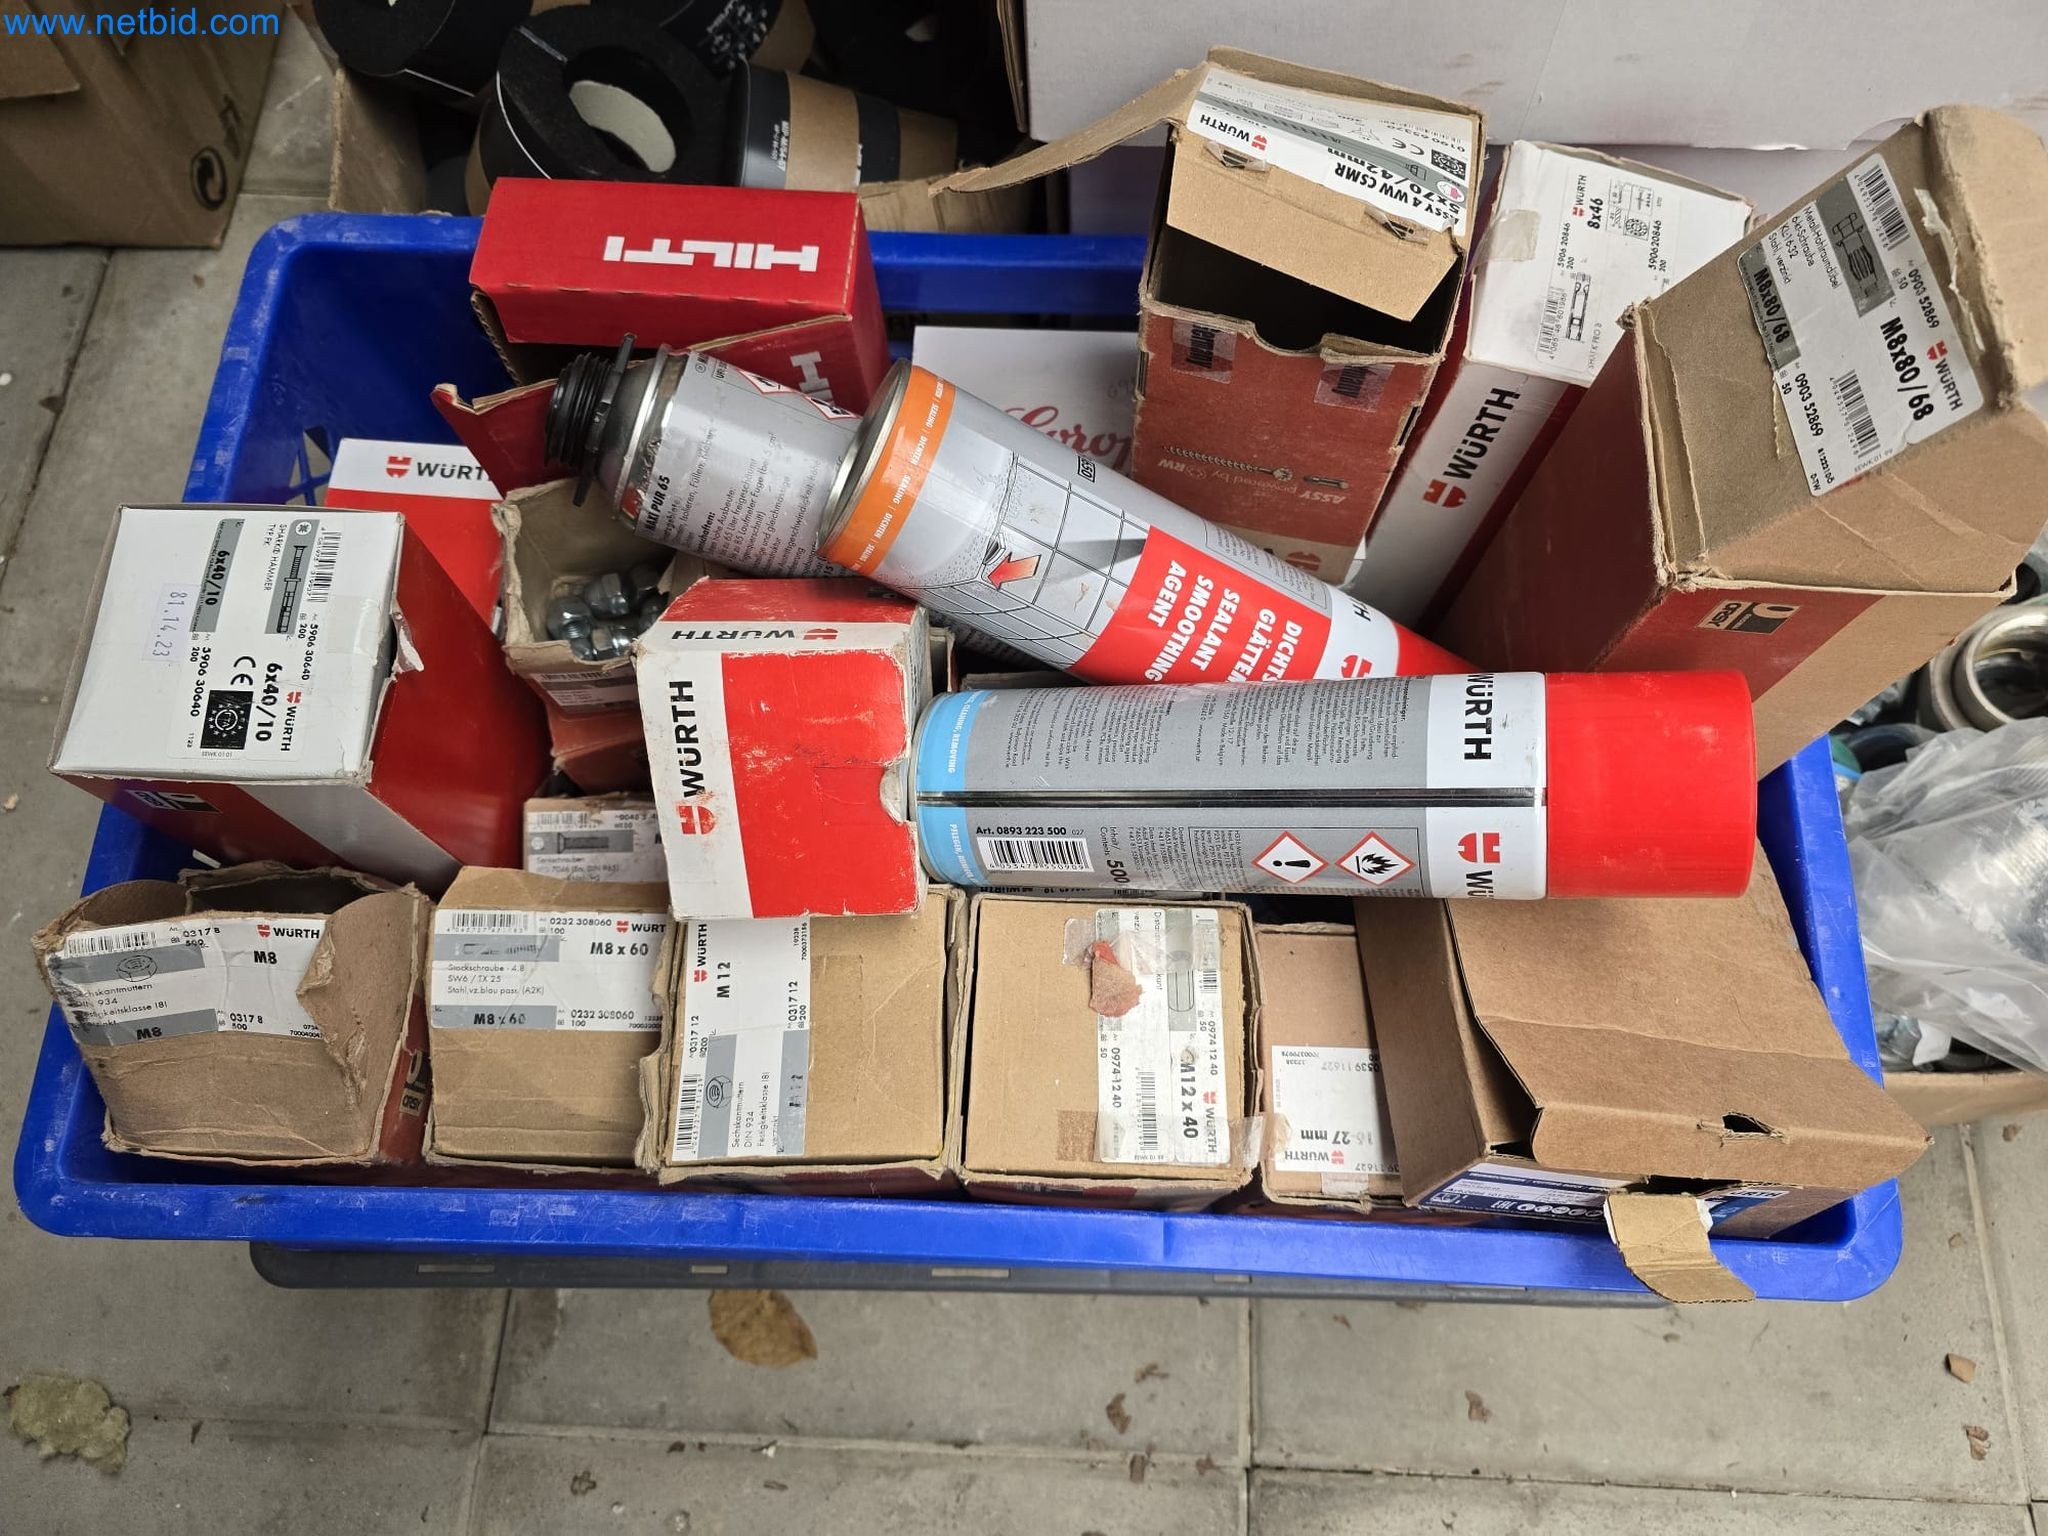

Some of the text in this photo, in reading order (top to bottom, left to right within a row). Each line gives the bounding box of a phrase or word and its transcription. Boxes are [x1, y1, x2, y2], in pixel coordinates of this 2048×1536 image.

[1200, 113, 1249, 142] WÜRTH
[1335, 162, 1378, 189] CSMR
[1379, 181, 1410, 203] WW
[1587, 197, 1604, 231] 8x46
[603, 235, 819, 272] HILTI
[1566, 256, 1574, 270] 200
[1658, 259, 1667, 272] 200
[1753, 268, 1790, 344] M8x80/68
[1909, 268, 1940, 329] 0903 52869
[1880, 316, 1934, 421] M8x80/68
[1782, 382, 1791, 395] 50
[1935, 357, 1963, 411] WÜRTH
[1794, 373, 1824, 437] 0903 52869
[1443, 387, 1521, 480] WÜRTH
[912, 435, 928, 466] DICHTEN
[416, 459, 488, 482] WÜRT
[651, 491, 665, 514] PUR
[660, 474, 671, 493] 65
[895, 474, 912, 506] SEALING
[1300, 491, 1346, 504] ASSY
[875, 513, 893, 541] DICHTEN
[204, 550, 231, 606] 6x40/10
[1147, 560, 1187, 628] AGENT
[151, 589, 188, 658] 81.14.23
[298, 623, 307, 639] 200
[671, 630, 796, 640] WÜRTH
[1144, 574, 1214, 681] SMOOTHING
[1191, 588, 1240, 671] SEALANT
[189, 646, 200, 663] 200
[301, 623, 318, 681] 5906 30640
[1261, 621, 1303, 682] DICHTS
[190, 647, 211, 717] 5906 30640
[255, 662, 283, 743] 6x40/10
[280, 706, 297, 752] WÜRTH
[1464, 674, 1493, 761] WÜRTH
[669, 680, 706, 798] WÜRTH
[947, 734, 960, 774] REMOVING
[976, 826, 995, 836] Art.
[997, 826, 1024, 836] 0893
[1025, 826, 1045, 836] 223
[1047, 826, 1067, 836] 500
[1106, 859, 1131, 884] 500
[273, 927, 320, 939] WÜRTH
[549, 918, 612, 927] 0232 308060
[550, 927, 565, 935] 100
[631, 924, 666, 933] WÜRT
[253, 950, 278, 965] M8
[590, 942, 649, 956] M8 x 60
[697, 924, 708, 967] WÜRTH
[448, 974, 469, 983] SW6
[490, 975, 502, 983] 25
[521, 985, 545, 996] (A2K)
[717, 961, 731, 998] M 12
[789, 981, 798, 995] 12
[229, 1013, 264, 1024] 0317 8
[473, 1013, 495, 1025] M8
[509, 1013, 527, 1025] 60
[571, 1010, 634, 1020] 0232 308060
[691, 1015, 699, 1028] 12
[798, 1004, 807, 1022] 200
[137, 1027, 162, 1040] M8
[1199, 1021, 1207, 1032] 50
[701, 1036, 709, 1052] 200
[1100, 1048, 1108, 1059] 50
[1208, 1020, 1218, 1076] 0974 12 40
[1111, 1047, 1121, 1075] 0974
[1355, 1063, 1380, 1072] 0539
[1112, 1095, 1121, 1109] 40
[1182, 1099, 1194, 1112] x
[744, 1111, 754, 1148] DIN 934
[1183, 1117, 1198, 1139] 40
[1204, 1108, 1217, 1154] WÜRTH
[1300, 1130, 1328, 1140] mm
[1285, 1150, 1330, 1161] WÜRTH
